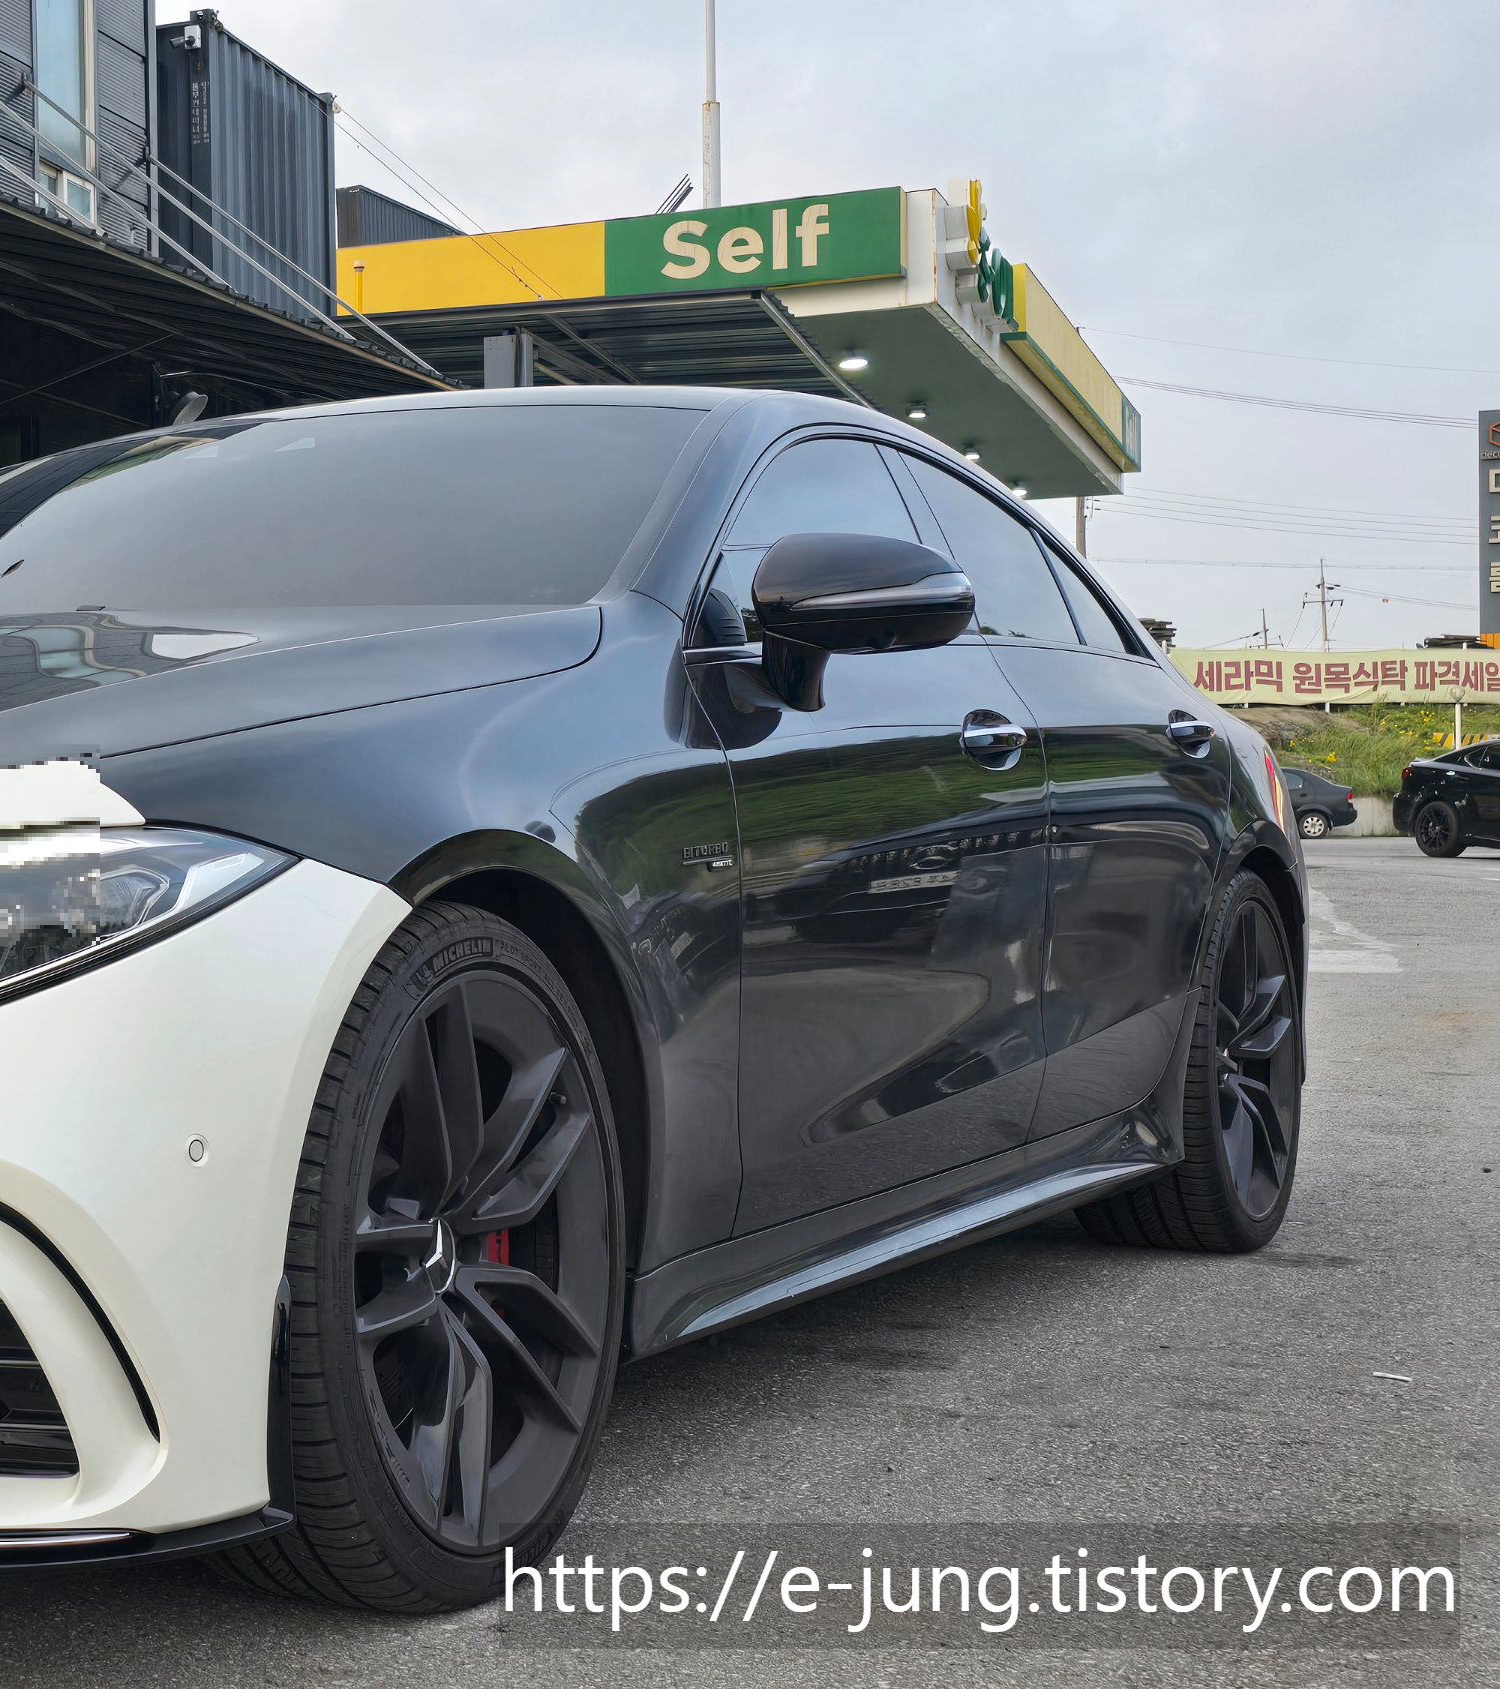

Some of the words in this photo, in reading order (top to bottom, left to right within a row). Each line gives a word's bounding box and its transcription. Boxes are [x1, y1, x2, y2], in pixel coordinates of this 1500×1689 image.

[660, 203, 830, 280] Self
[1193, 659, 1283, 693] 세라믹
[1292, 659, 1408, 694] 원목식탁
[432, 939, 492, 973] MICHELIN
